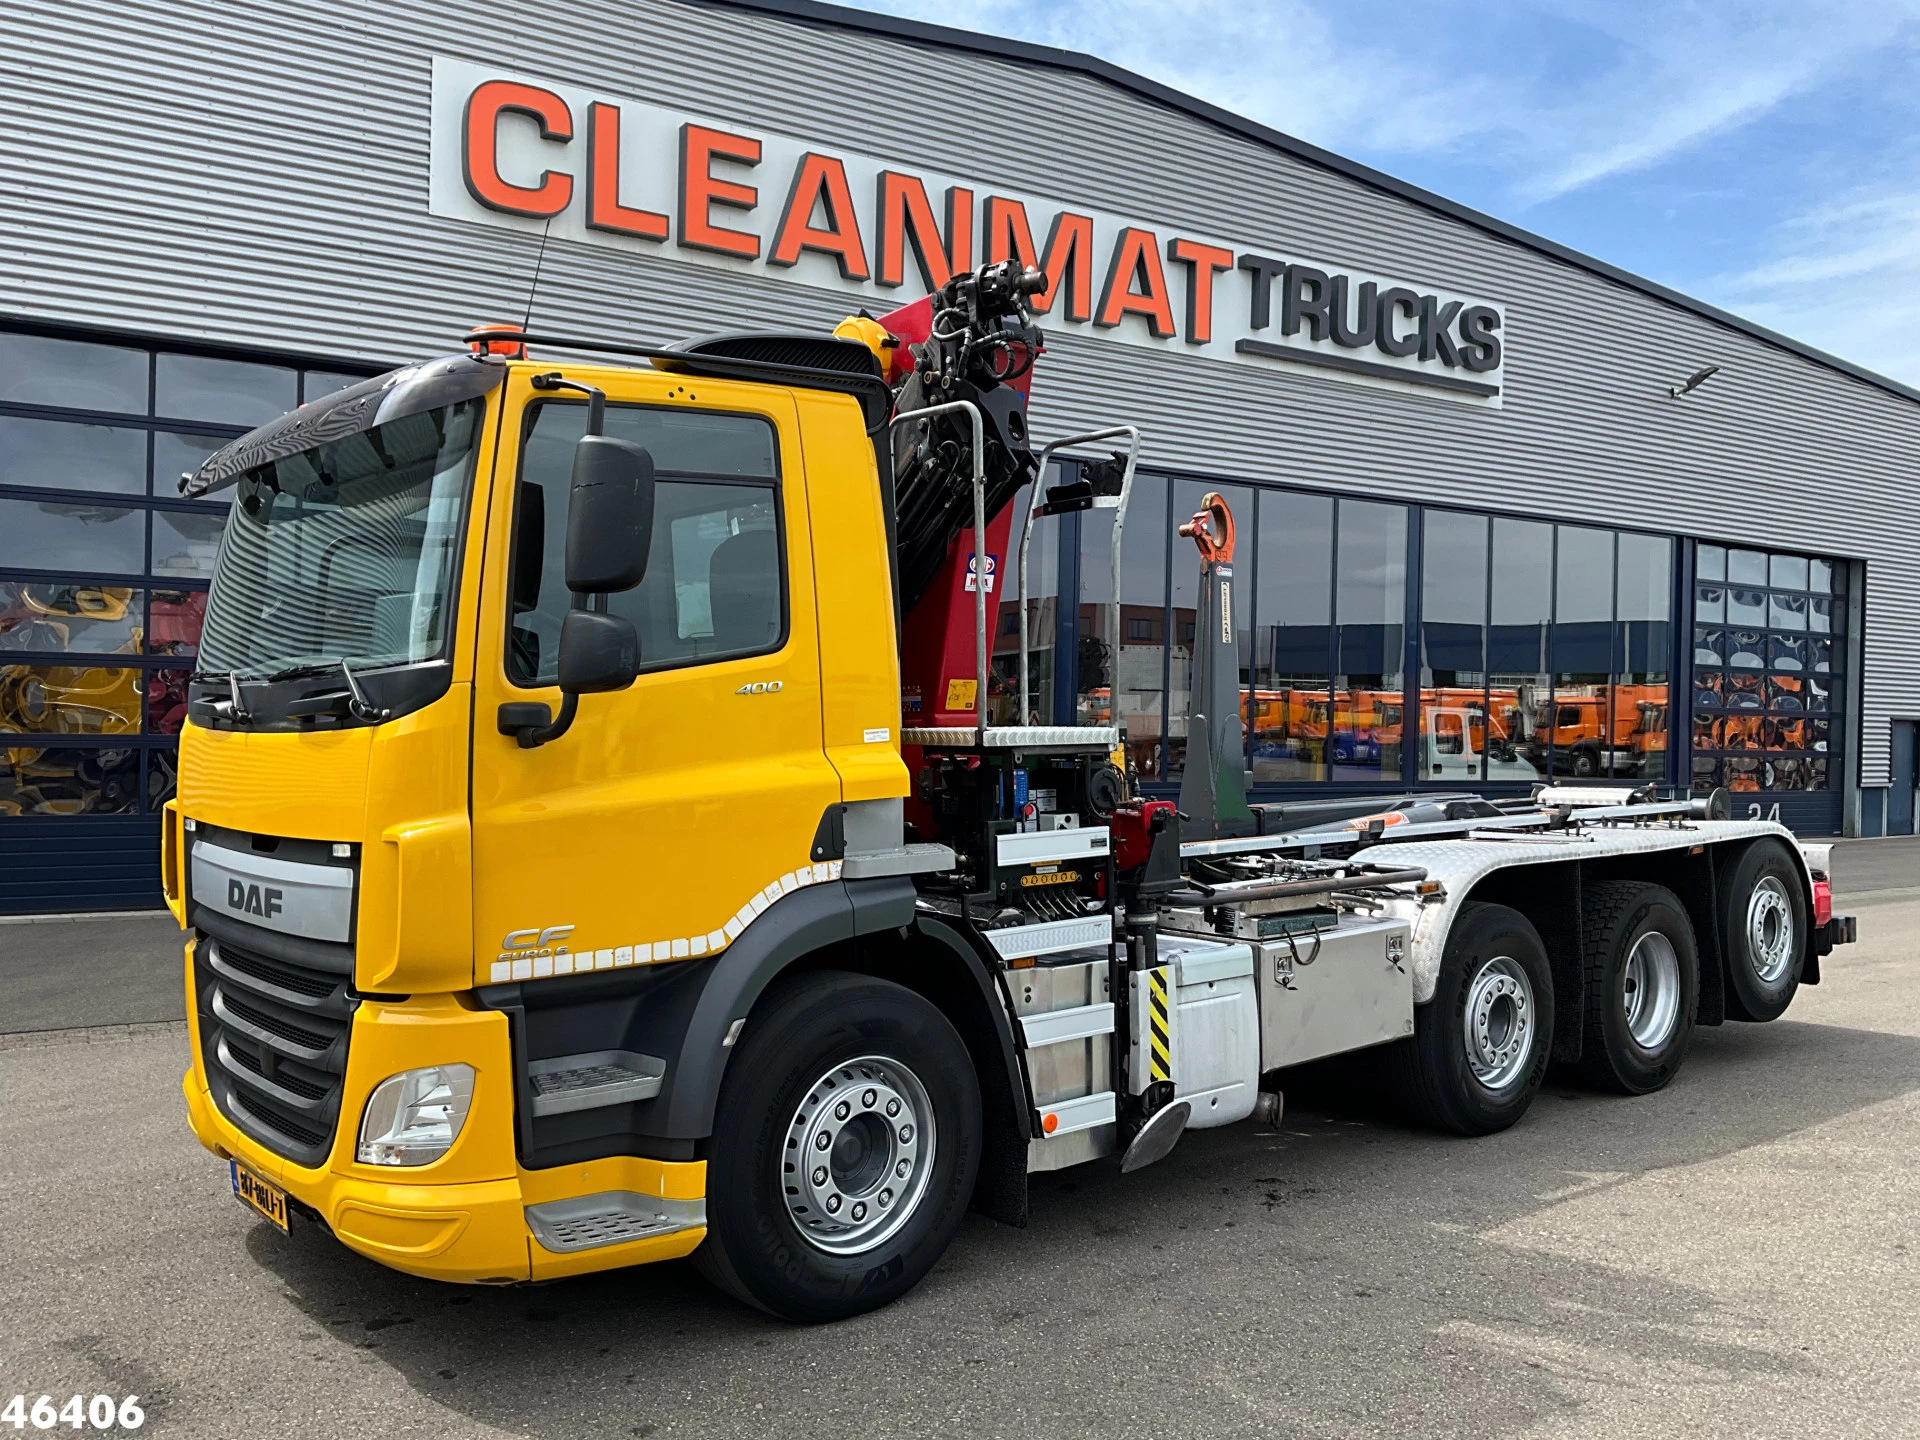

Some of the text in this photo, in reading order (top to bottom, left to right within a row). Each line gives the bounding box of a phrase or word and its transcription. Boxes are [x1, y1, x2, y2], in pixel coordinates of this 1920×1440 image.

[461, 79, 1502, 373] CLEANMAT TRUCKS
[735, 681, 783, 695] 400
[1748, 802, 1781, 824] 24
[227, 878, 283, 919] DAF
[502, 924, 575, 950] CF
[497, 945, 569, 962] EURO 6
